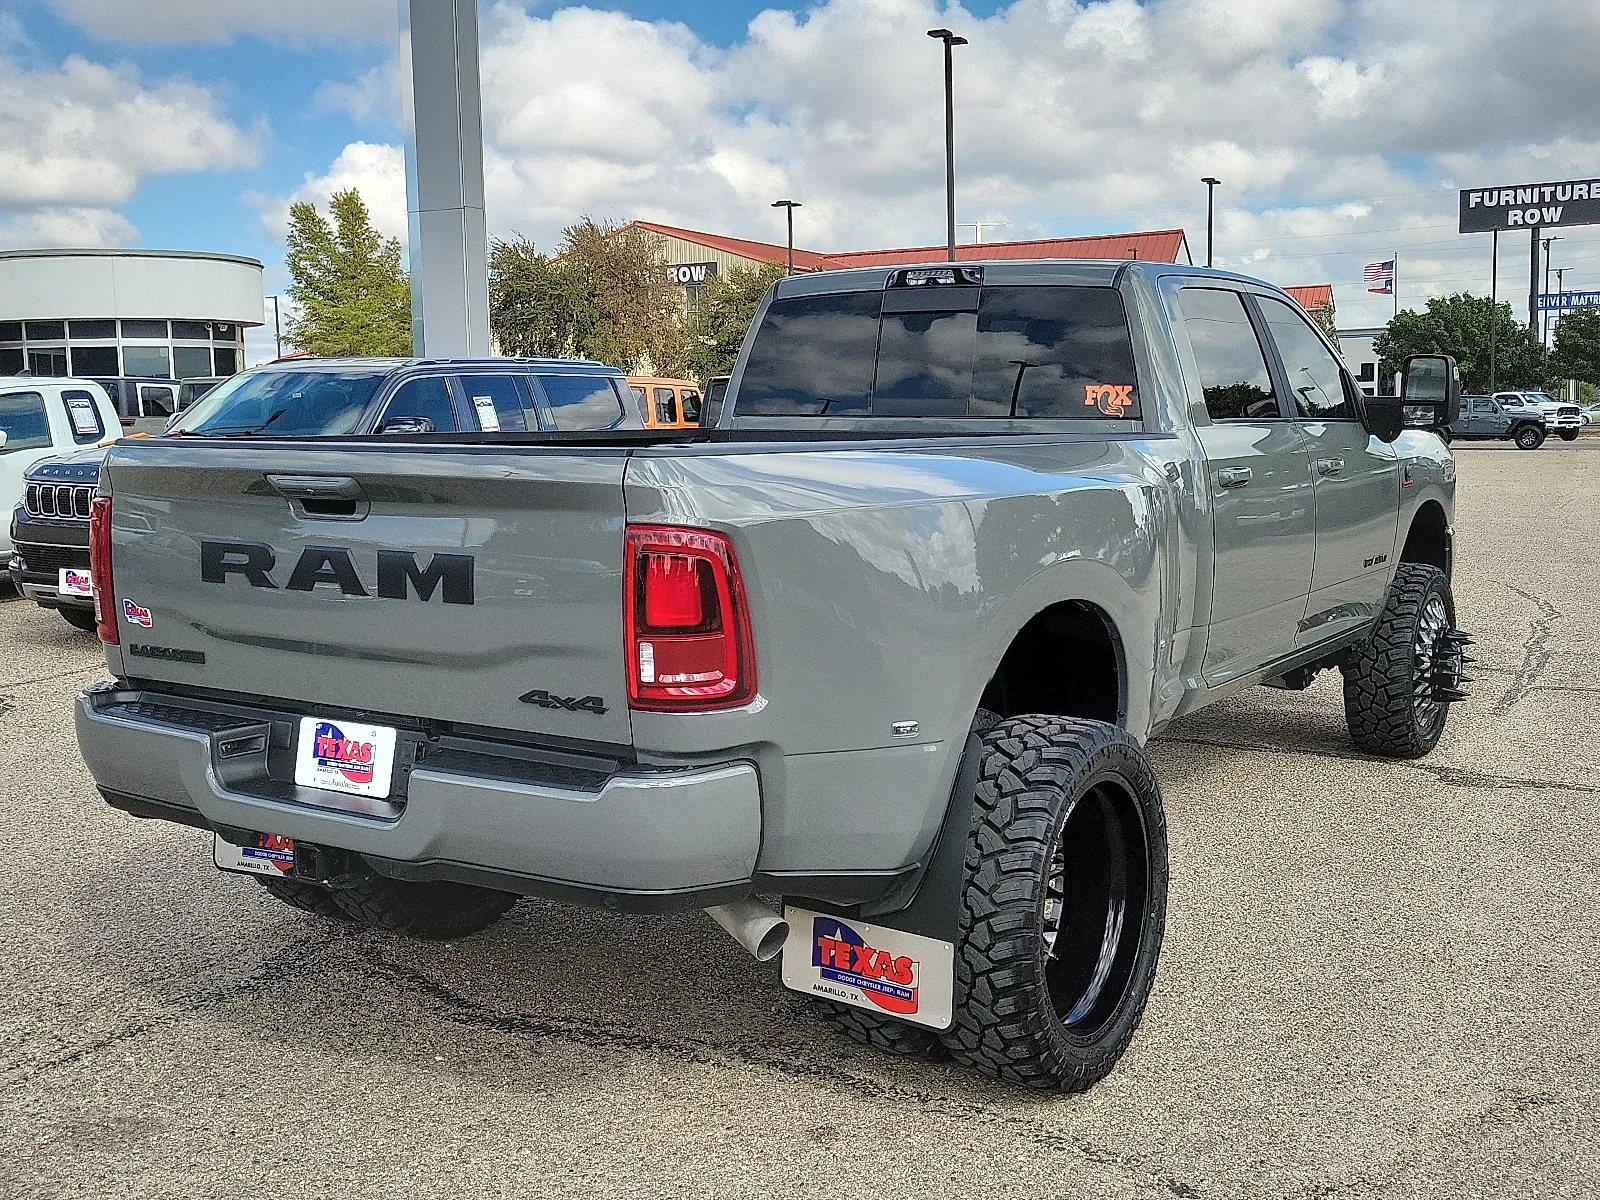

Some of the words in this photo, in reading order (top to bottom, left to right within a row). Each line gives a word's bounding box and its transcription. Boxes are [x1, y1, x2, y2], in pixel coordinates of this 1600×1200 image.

[1469, 182, 1600, 208] FURNITURE
[1507, 206, 1563, 226] ROW
[667, 265, 706, 283] ROW
[1537, 296, 1567, 308] ENVER
[1571, 293, 1600, 306] MATTR
[1084, 384, 1133, 418] FOX
[42, 468, 97, 477] WAGON
[201, 534, 475, 605] RAM
[518, 690, 609, 715] 4x4
[317, 736, 373, 764] TEXAS
[817, 935, 914, 986] TEXAS
[837, 974, 856, 984] DODGE
[856, 979, 881, 991] CHRYSLER
[896, 990, 910, 998] RAM
[850, 992, 859, 1002] TX
